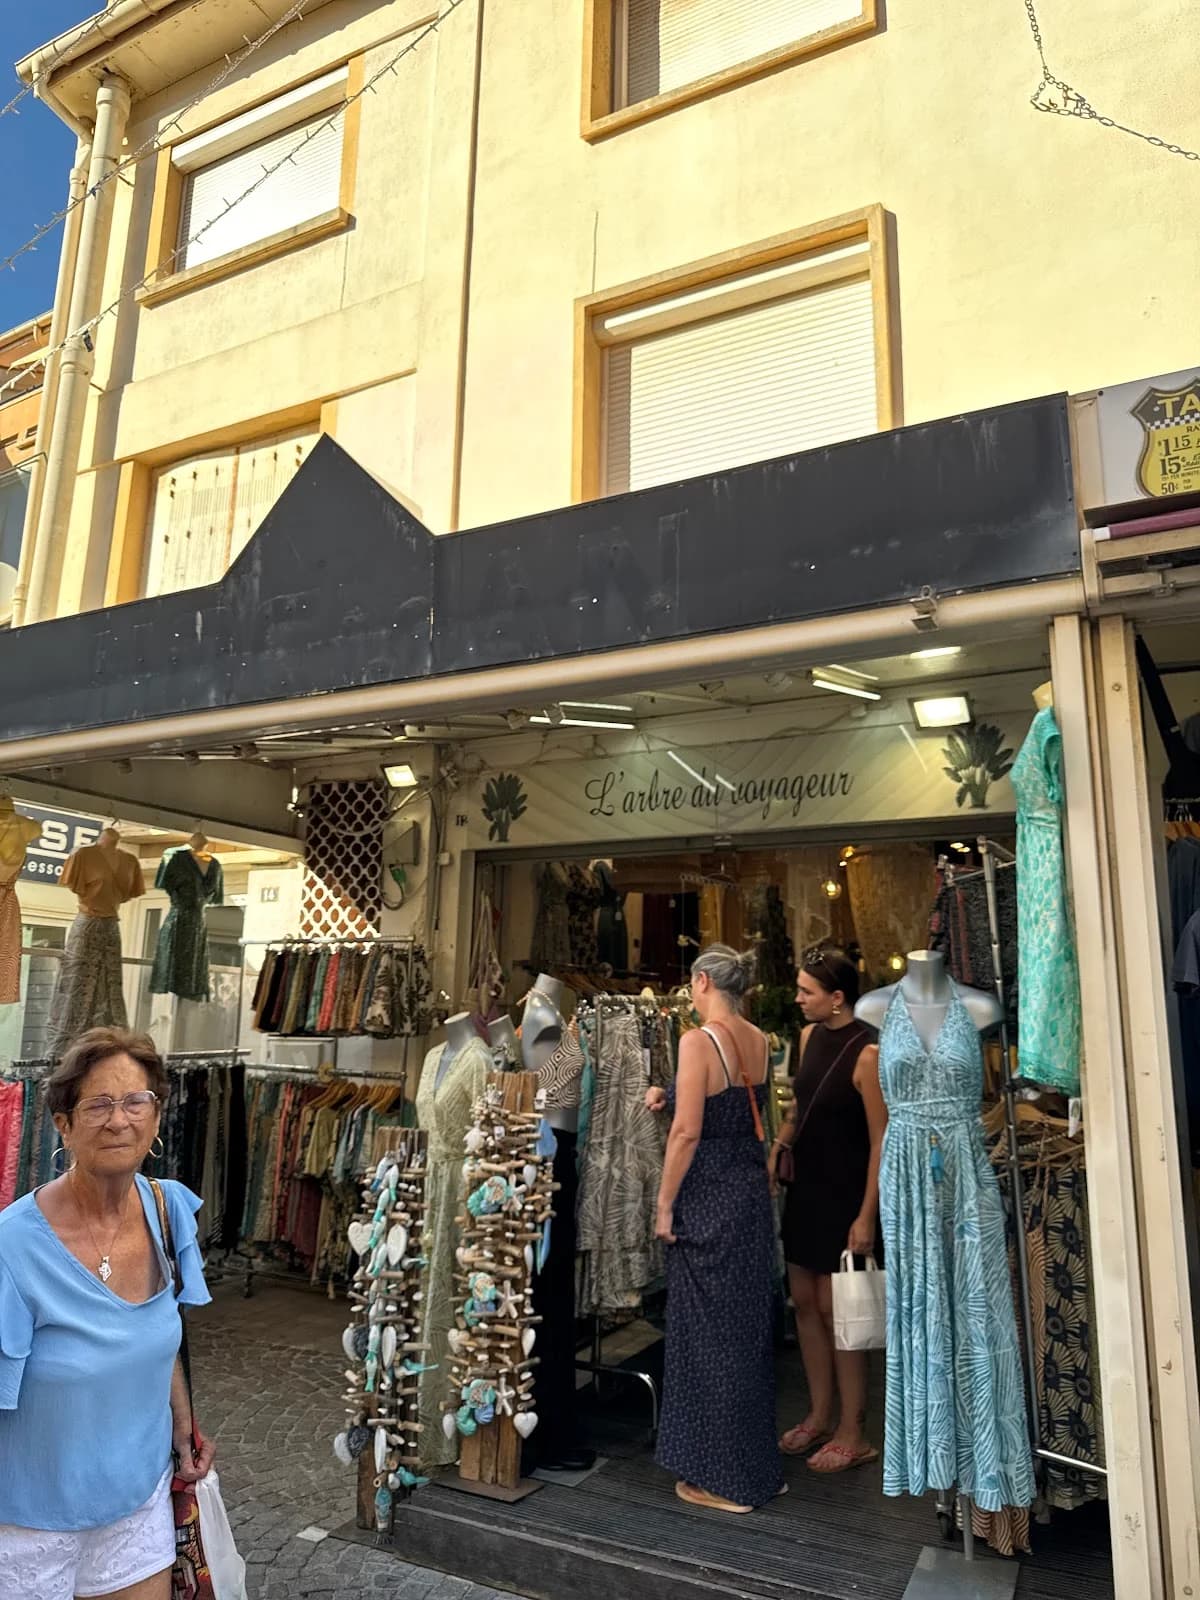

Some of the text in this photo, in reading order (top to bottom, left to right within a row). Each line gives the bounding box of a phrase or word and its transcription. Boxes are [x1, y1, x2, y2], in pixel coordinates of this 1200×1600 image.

[585, 767, 853, 820] L'arbre du voyageur
[22, 860, 64, 876] esso
